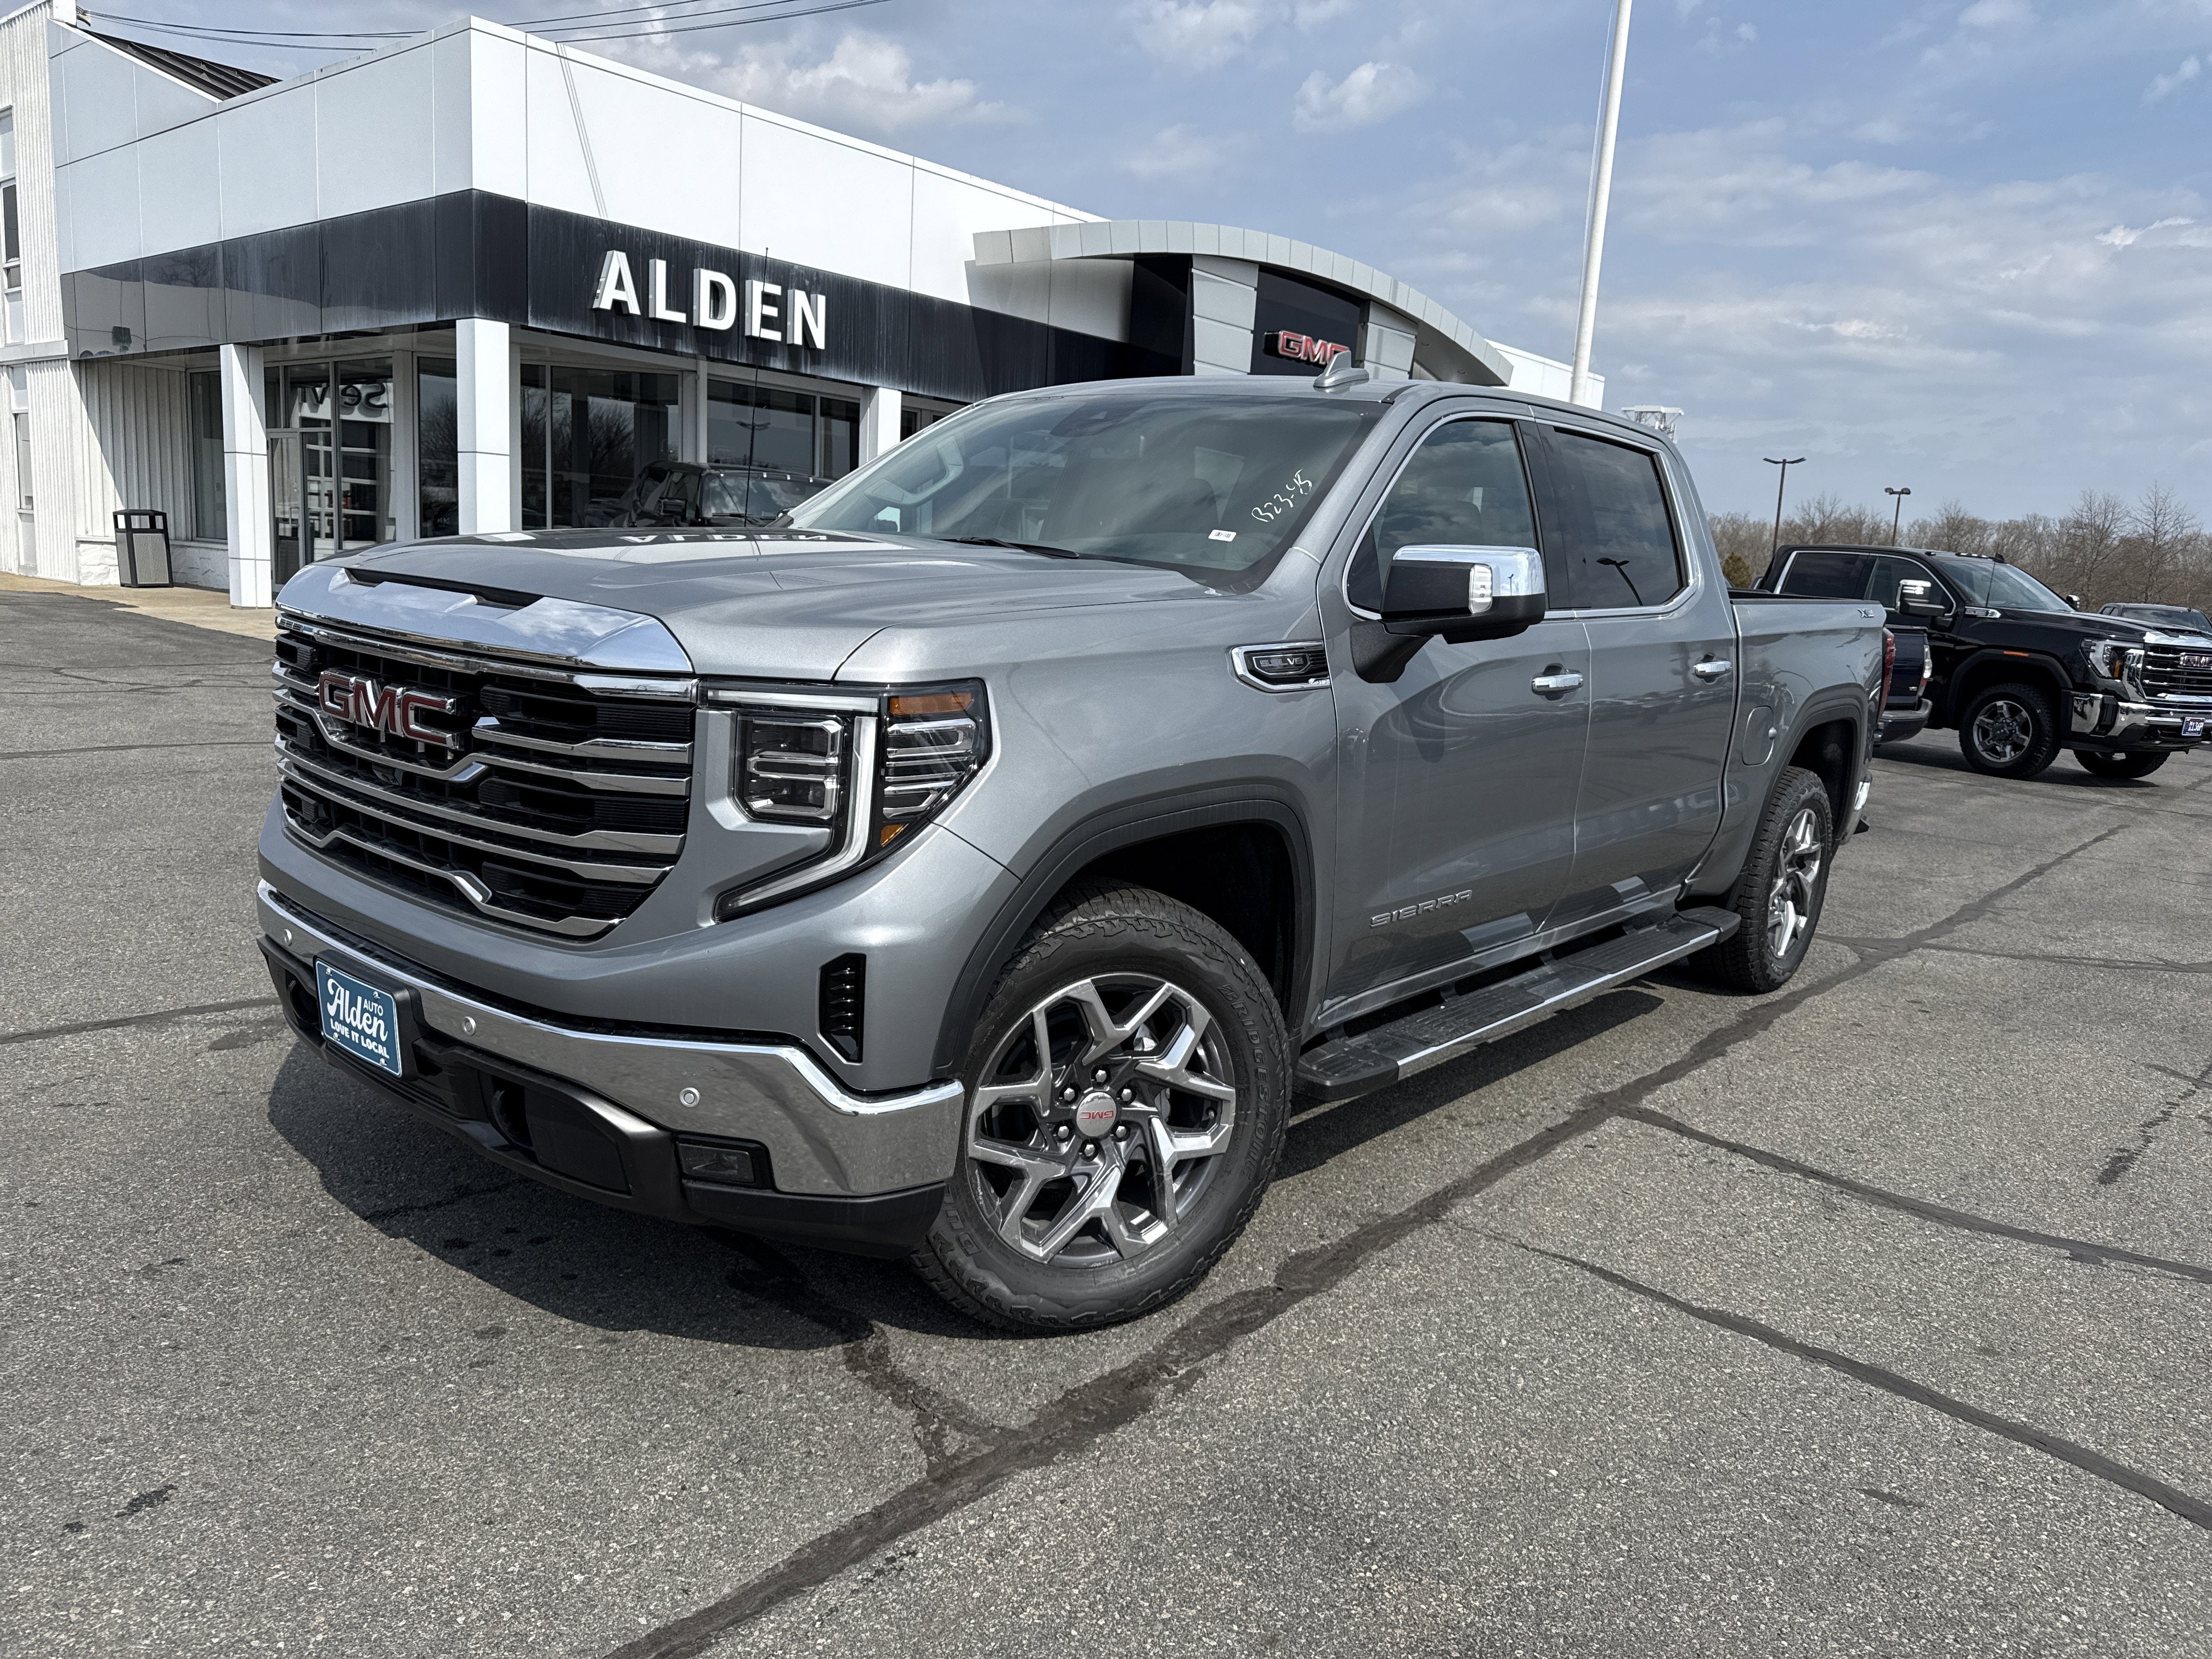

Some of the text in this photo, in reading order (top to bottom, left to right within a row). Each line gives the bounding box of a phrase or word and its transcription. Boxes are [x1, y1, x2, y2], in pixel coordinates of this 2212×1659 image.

[592, 250, 826, 350] ALDEN
[319, 670, 456, 750] GMC
[1370, 889, 1473, 927] SIERRA
[327, 978, 388, 1042] Alden
[363, 999, 383, 1016] AUTO
[330, 1018, 390, 1059] LOVE IT LOCAL
[1217, 984, 1271, 1181] BRIDGESTONE
[1080, 1109, 1114, 1120] GMC
